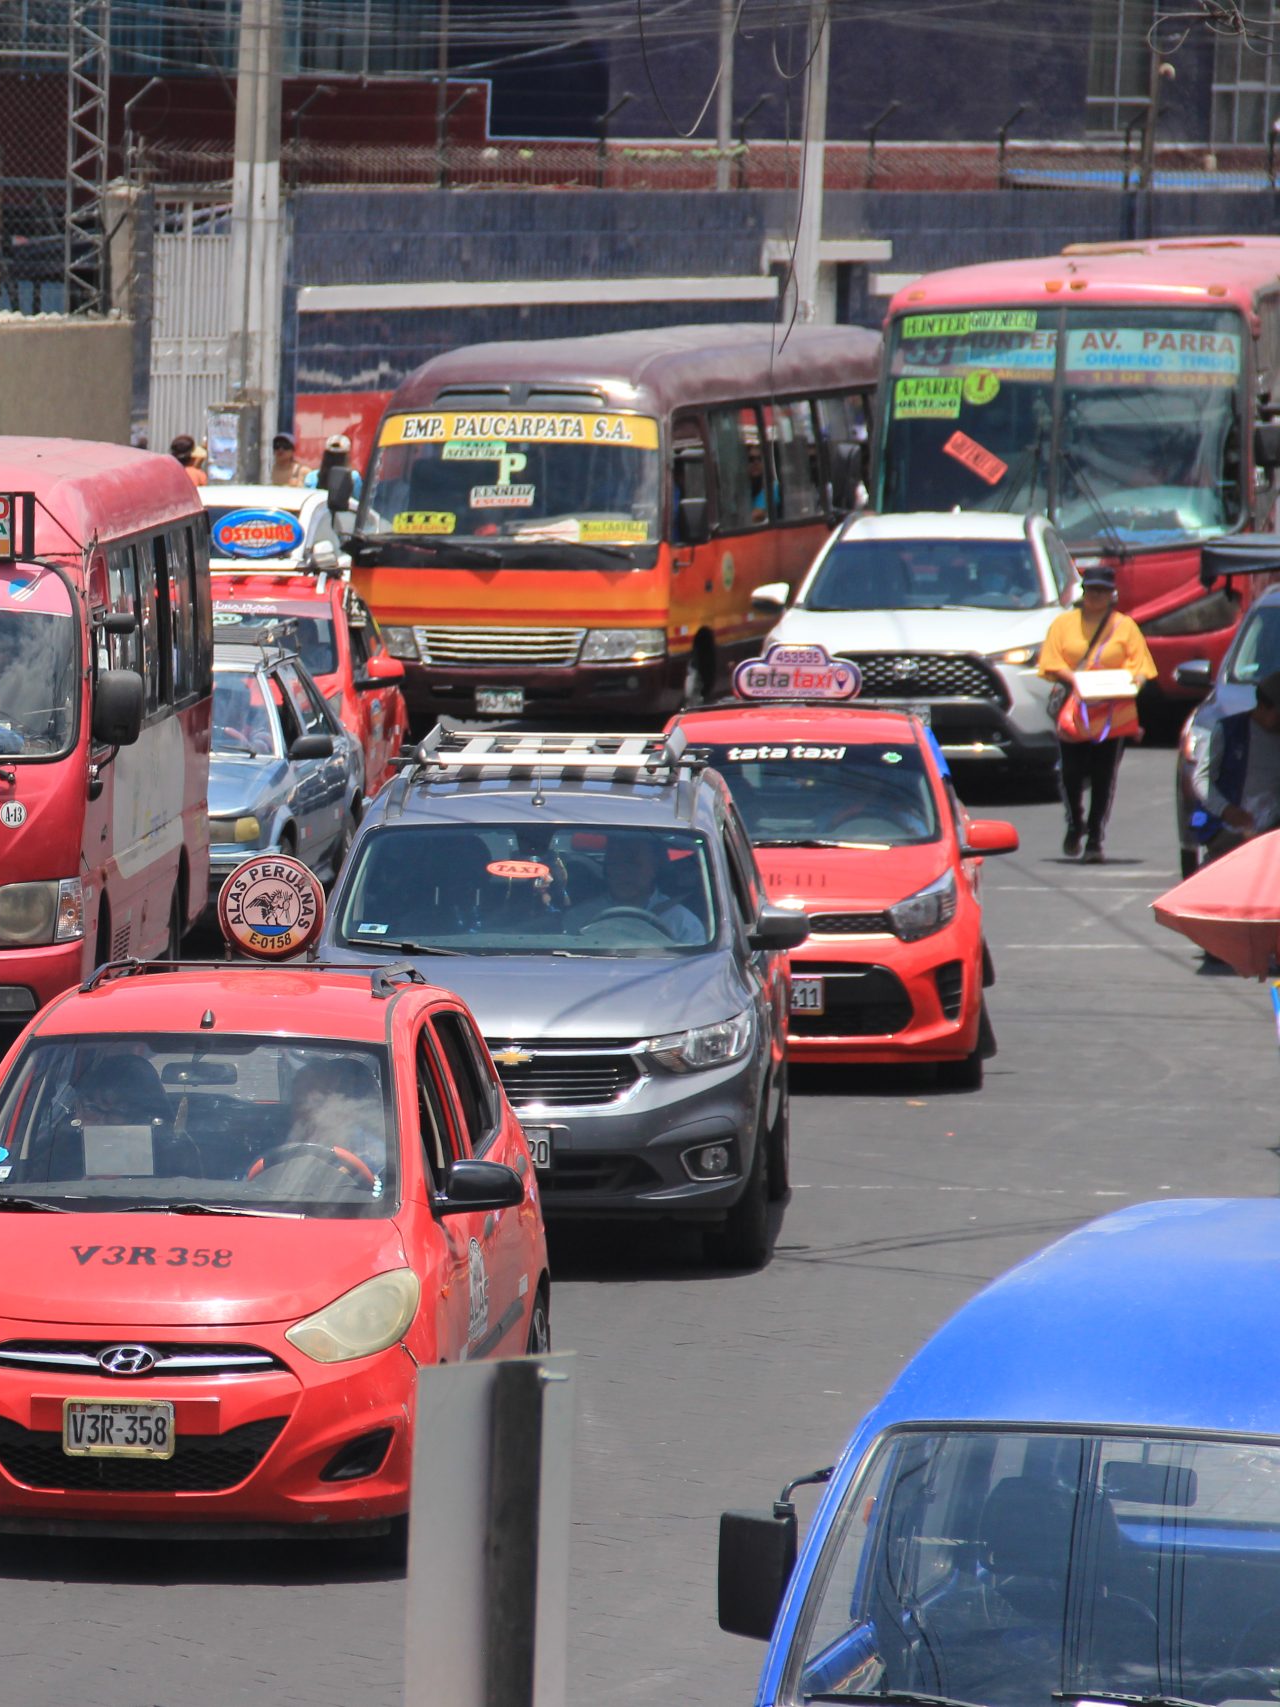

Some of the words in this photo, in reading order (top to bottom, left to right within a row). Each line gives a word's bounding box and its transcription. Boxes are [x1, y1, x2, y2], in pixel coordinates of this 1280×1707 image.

[1081, 332, 1122, 350] AV.
[1143, 332, 1236, 353] PARRA
[401, 418, 444, 439] EMP.
[453, 417, 584, 439] PAUCARPATA
[593, 418, 632, 440] S.A.
[497, 453, 527, 486] P
[220, 524, 294, 544] OSTOURS
[746, 668, 790, 688] tata
[793, 668, 833, 689] taxi
[727, 745, 789, 760] tata
[791, 745, 847, 760] taxi
[5, 806, 23, 823] A-13
[496, 864, 539, 874] TAXI
[228, 879, 248, 925] ALAS
[248, 864, 315, 930] PERUANAS
[248, 932, 292, 950] E-0158
[72, 1414, 167, 1446] V3R-358
